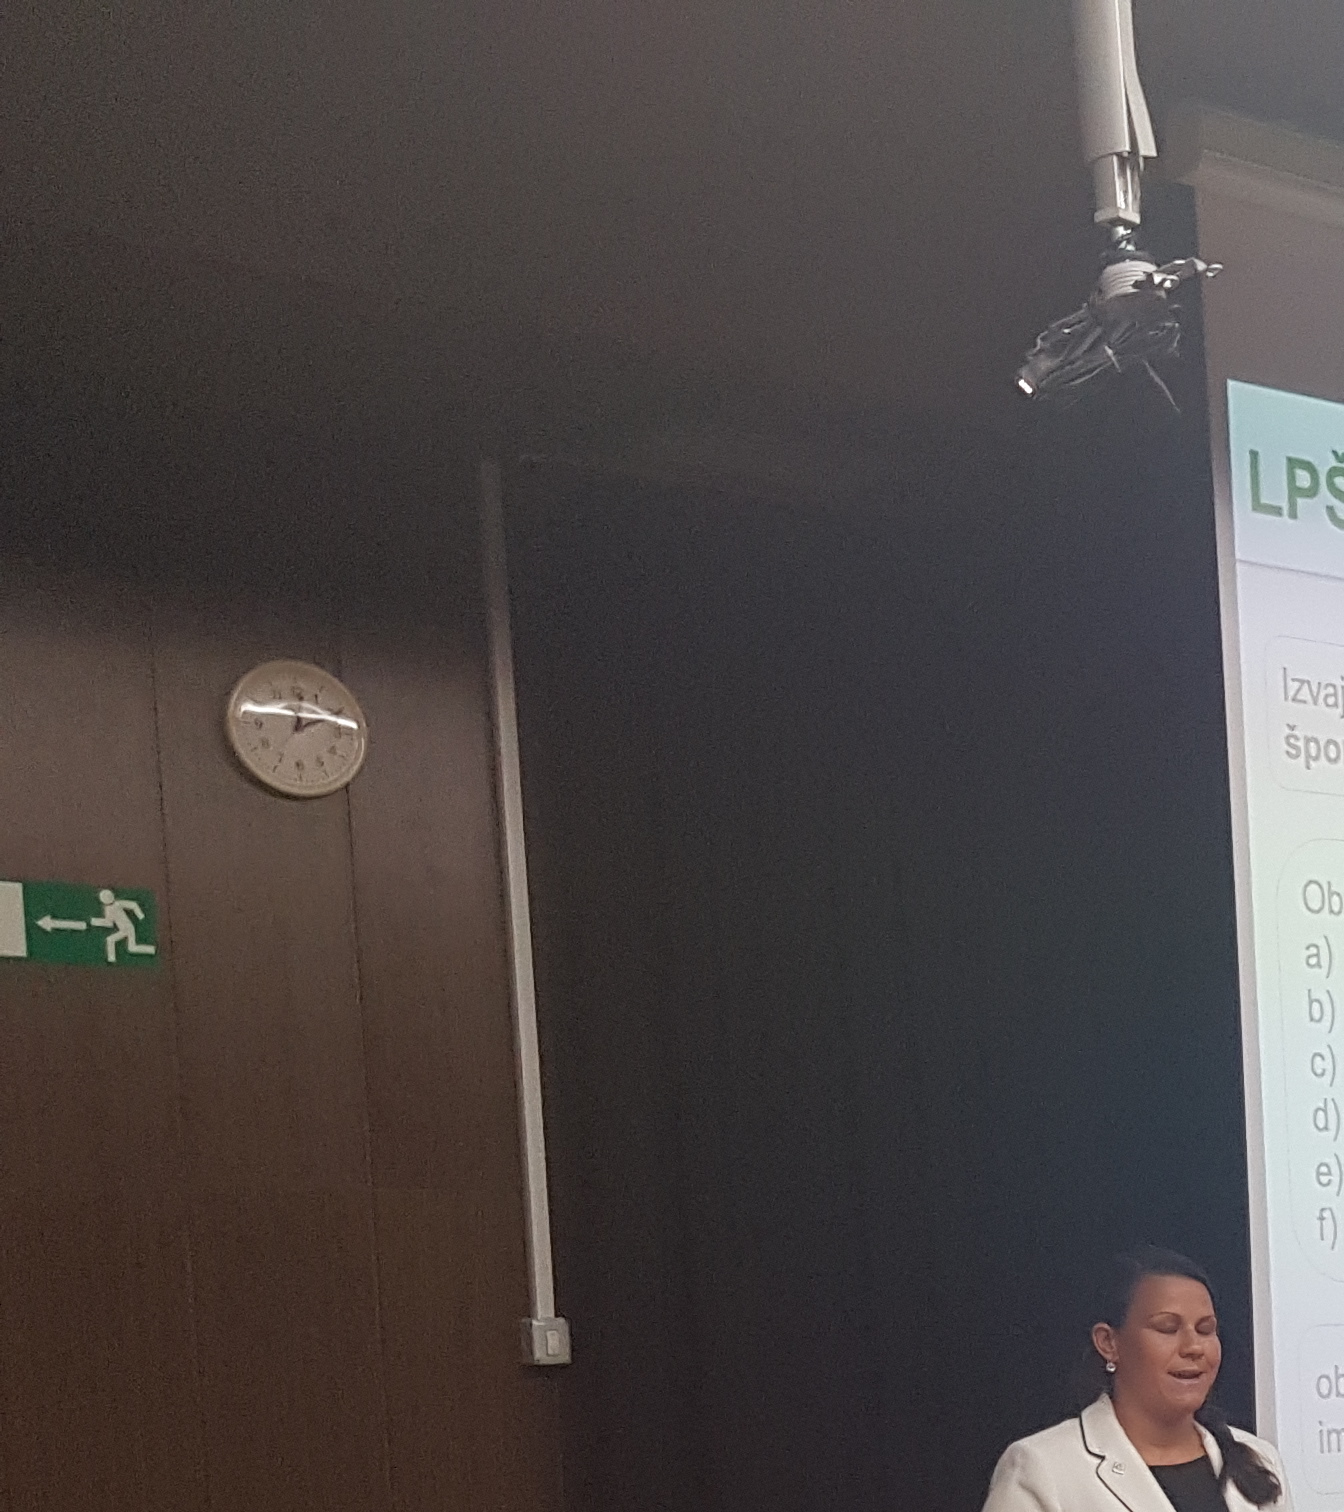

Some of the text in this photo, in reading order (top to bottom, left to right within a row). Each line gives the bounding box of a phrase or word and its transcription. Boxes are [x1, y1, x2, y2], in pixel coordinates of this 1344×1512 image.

[1305, 936, 1332, 979] a)
[1308, 989, 1335, 1033] b)
[1311, 1045, 1336, 1087] c)
[1313, 1098, 1340, 1142] d)
[1315, 1153, 1343, 1197] e)
[1316, 1207, 1338, 1250] f)
